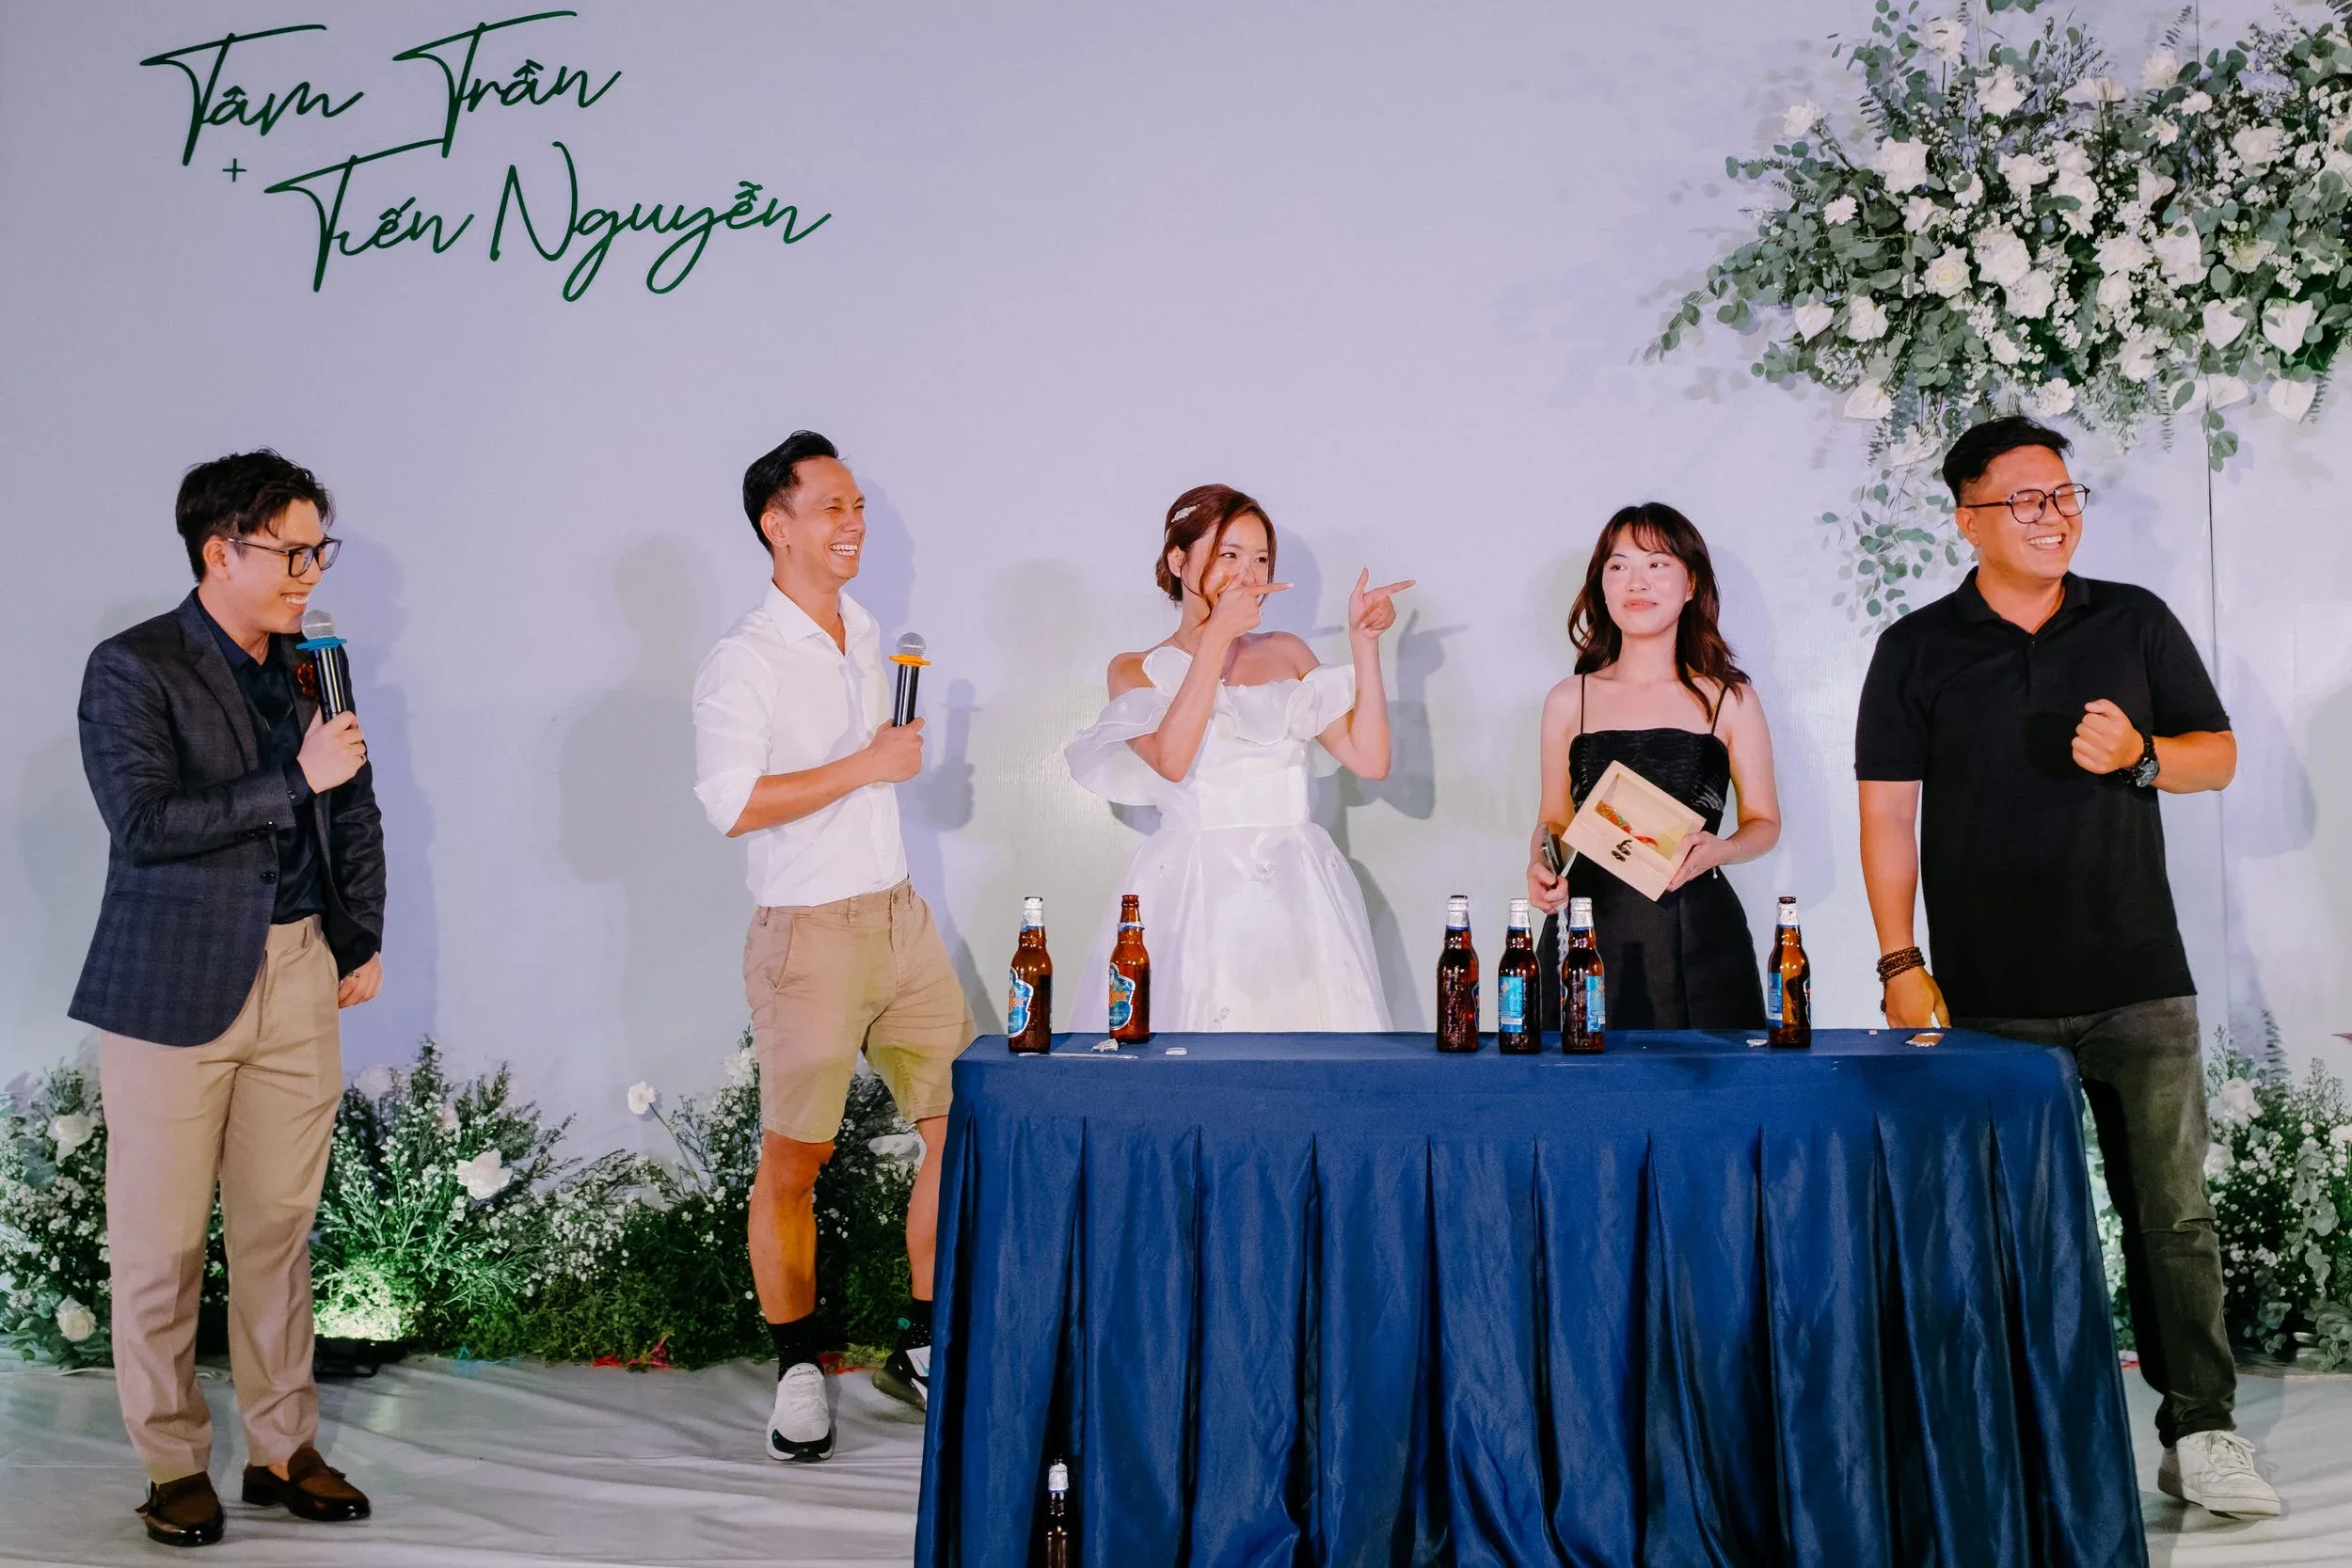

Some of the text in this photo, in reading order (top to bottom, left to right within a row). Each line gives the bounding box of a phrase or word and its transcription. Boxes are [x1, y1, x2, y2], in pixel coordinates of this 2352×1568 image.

[139, 10, 622, 166] Tâm Trần
[490, 141, 832, 302] Nguyễn
